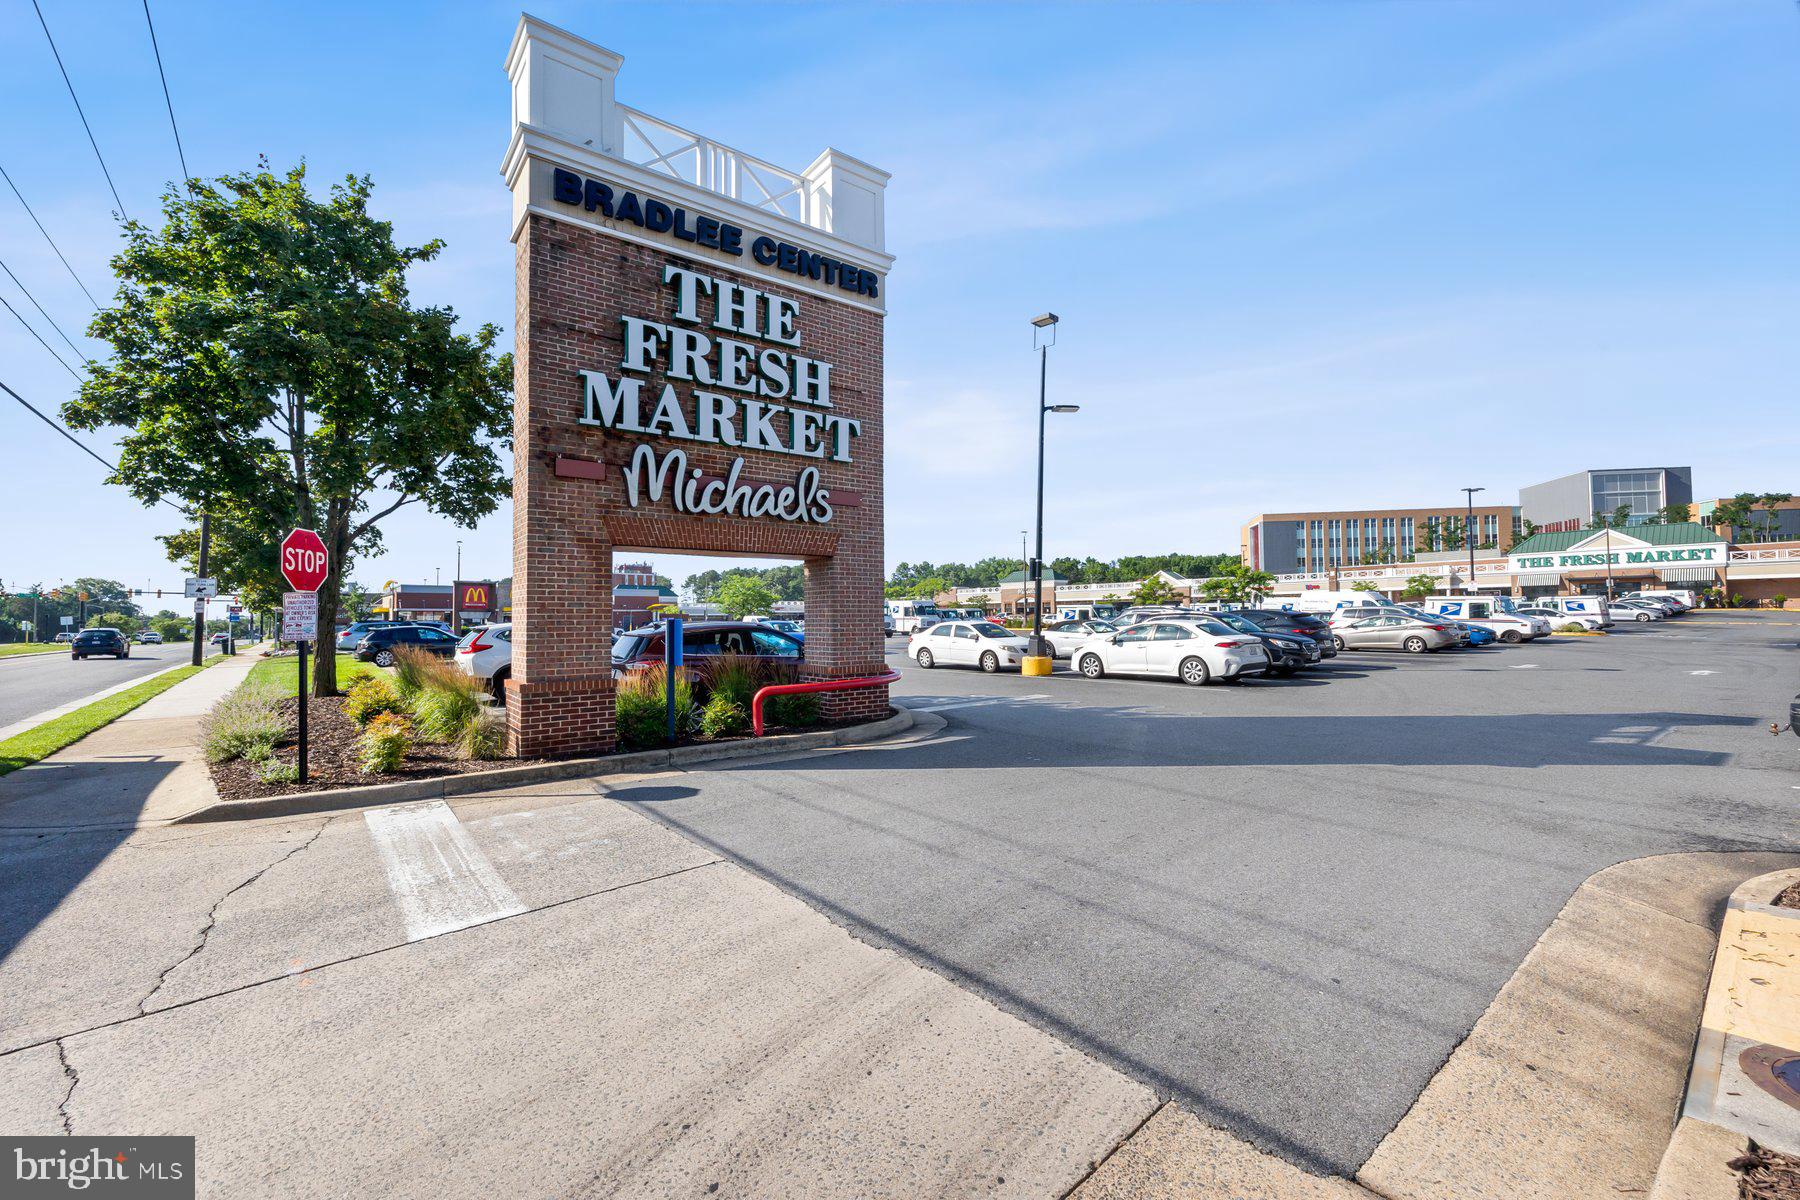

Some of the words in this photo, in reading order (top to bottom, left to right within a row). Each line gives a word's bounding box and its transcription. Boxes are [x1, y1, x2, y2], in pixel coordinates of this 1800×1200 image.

[553, 167, 743, 257] BRADLEE
[752, 236, 879, 298] CENTER
[663, 264, 801, 348] THE
[620, 315, 834, 408] FRESH
[578, 369, 861, 463] MARKET
[623, 444, 833, 523] Michaels
[285, 547, 325, 574] STOP
[1517, 556, 1554, 568] THE
[1559, 553, 1619, 567] FRESH
[1626, 547, 1716, 564] MARKET
